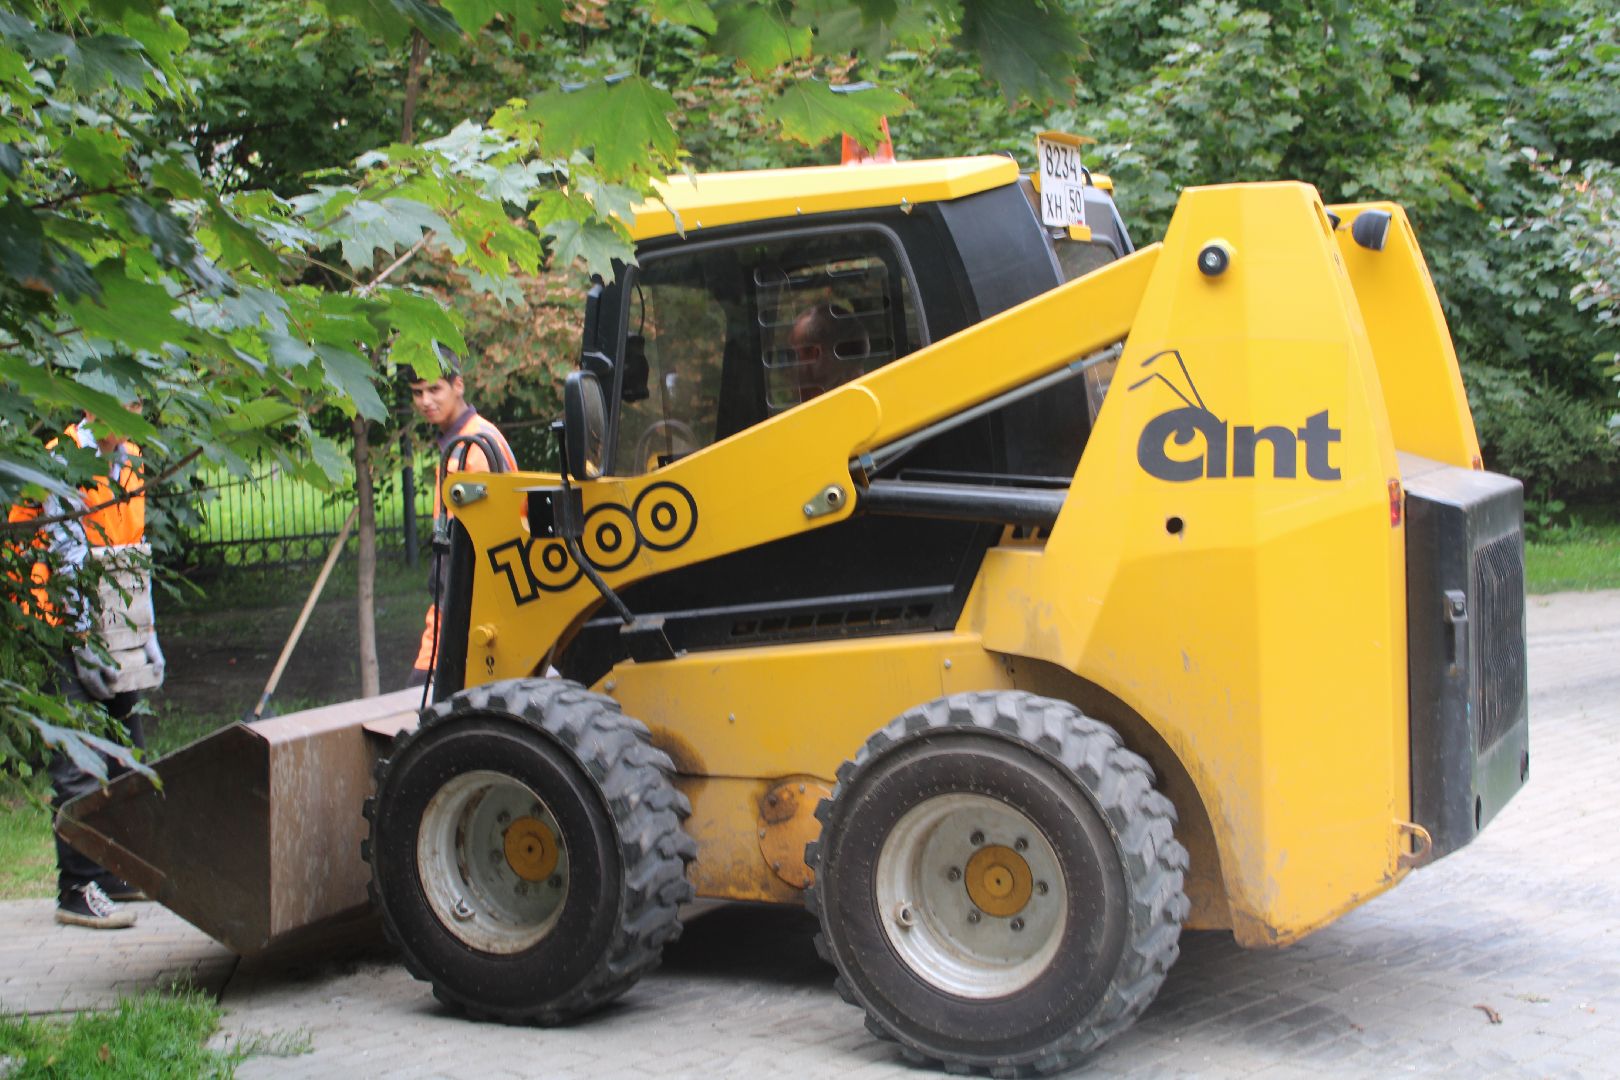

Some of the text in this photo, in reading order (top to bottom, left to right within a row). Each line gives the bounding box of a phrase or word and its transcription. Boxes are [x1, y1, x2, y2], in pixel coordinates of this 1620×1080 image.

[1045, 144, 1078, 182] 8234
[1069, 189, 1082, 214] 50
[1136, 404, 1342, 484] ant
[487, 480, 699, 607] 1000
